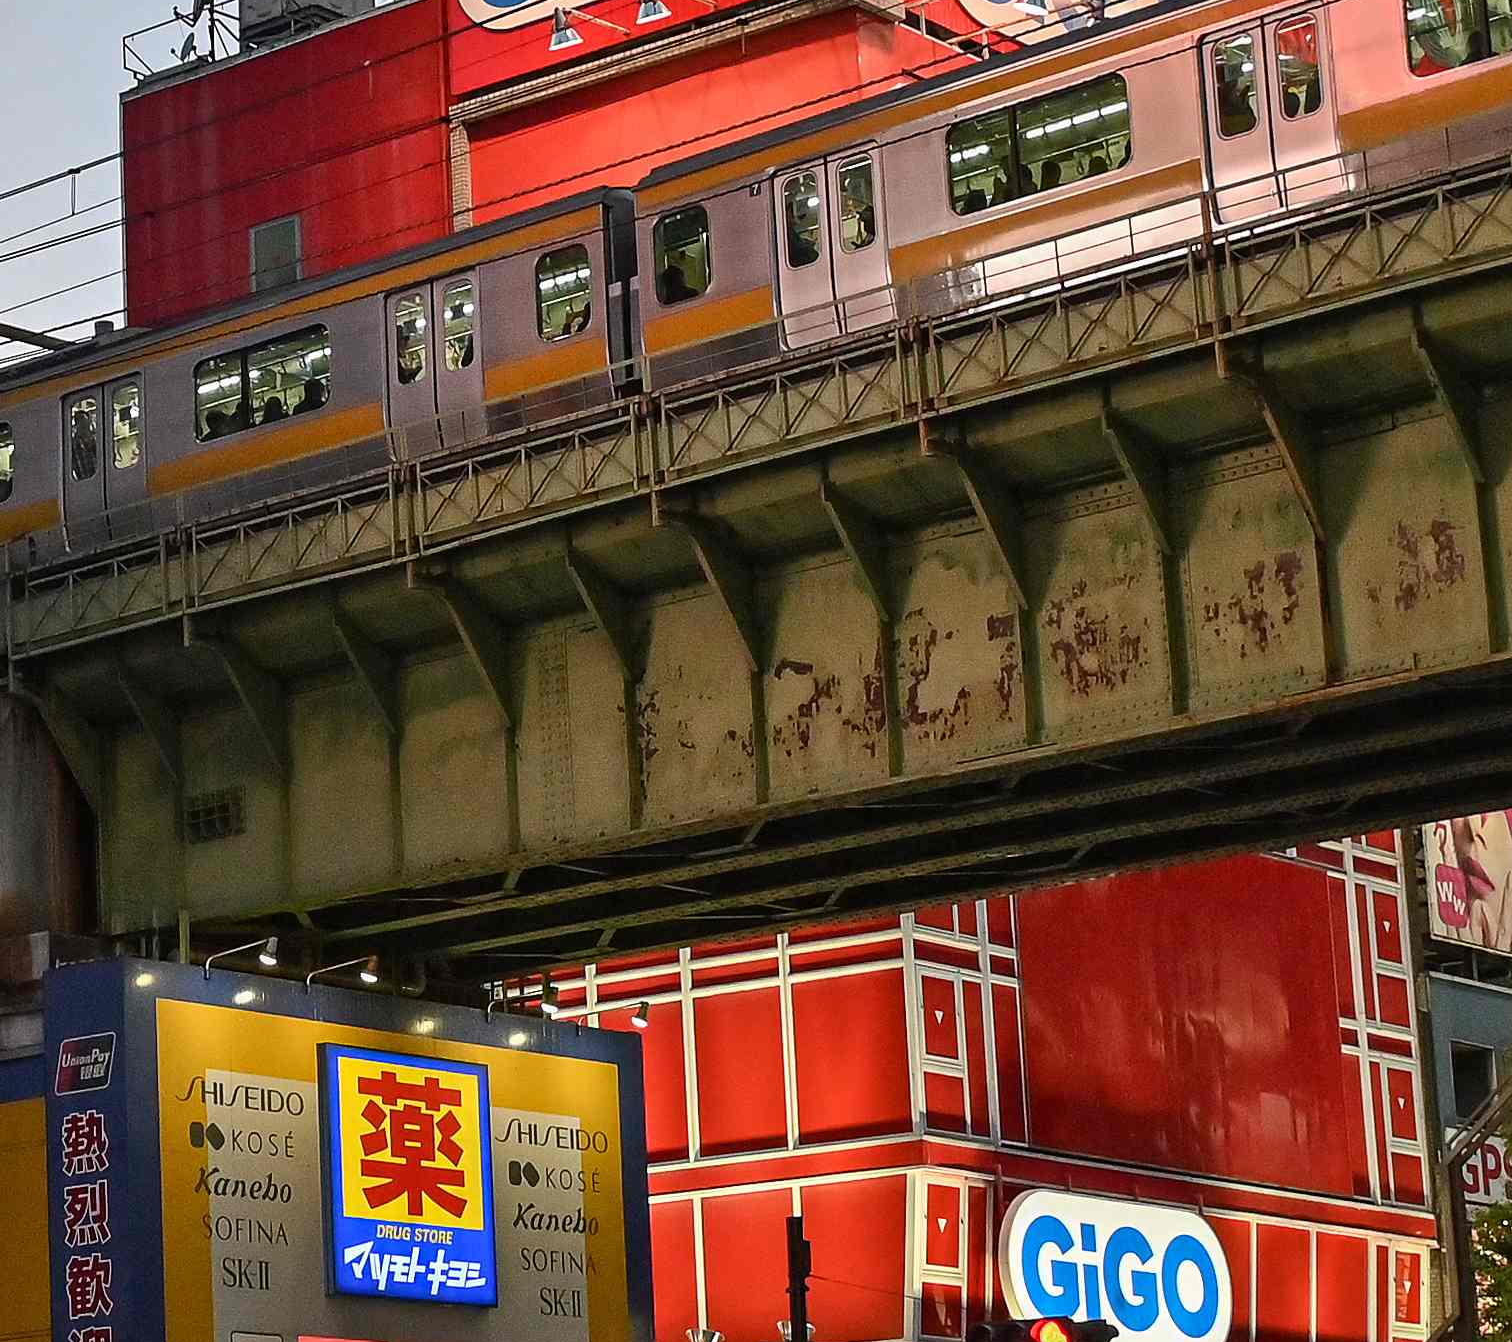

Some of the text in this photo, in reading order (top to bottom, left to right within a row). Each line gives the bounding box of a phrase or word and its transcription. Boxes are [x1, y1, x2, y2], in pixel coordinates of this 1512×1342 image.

[60, 1050, 112, 1070] UnionPay
[175, 1075, 305, 1118] SHISEIDO
[229, 1126, 296, 1159] KOSÉ
[357, 1071, 468, 1219] 薬
[494, 1117, 609, 1154] SHISEIDO
[192, 1167, 293, 1205] Kanebo
[544, 1163, 602, 1195] KOSÉ
[201, 1213, 289, 1247] SOFINA
[376, 1223, 454, 1245] DRUG STORE
[511, 1203, 601, 1237] Kanebo
[221, 1259, 271, 1291] SK-II
[343, 1241, 487, 1292] マツモトキヨシ
[520, 1247, 598, 1277] SOFINA
[1021, 1213, 1222, 1339] GiGO
[538, 1287, 585, 1319] SK-II
